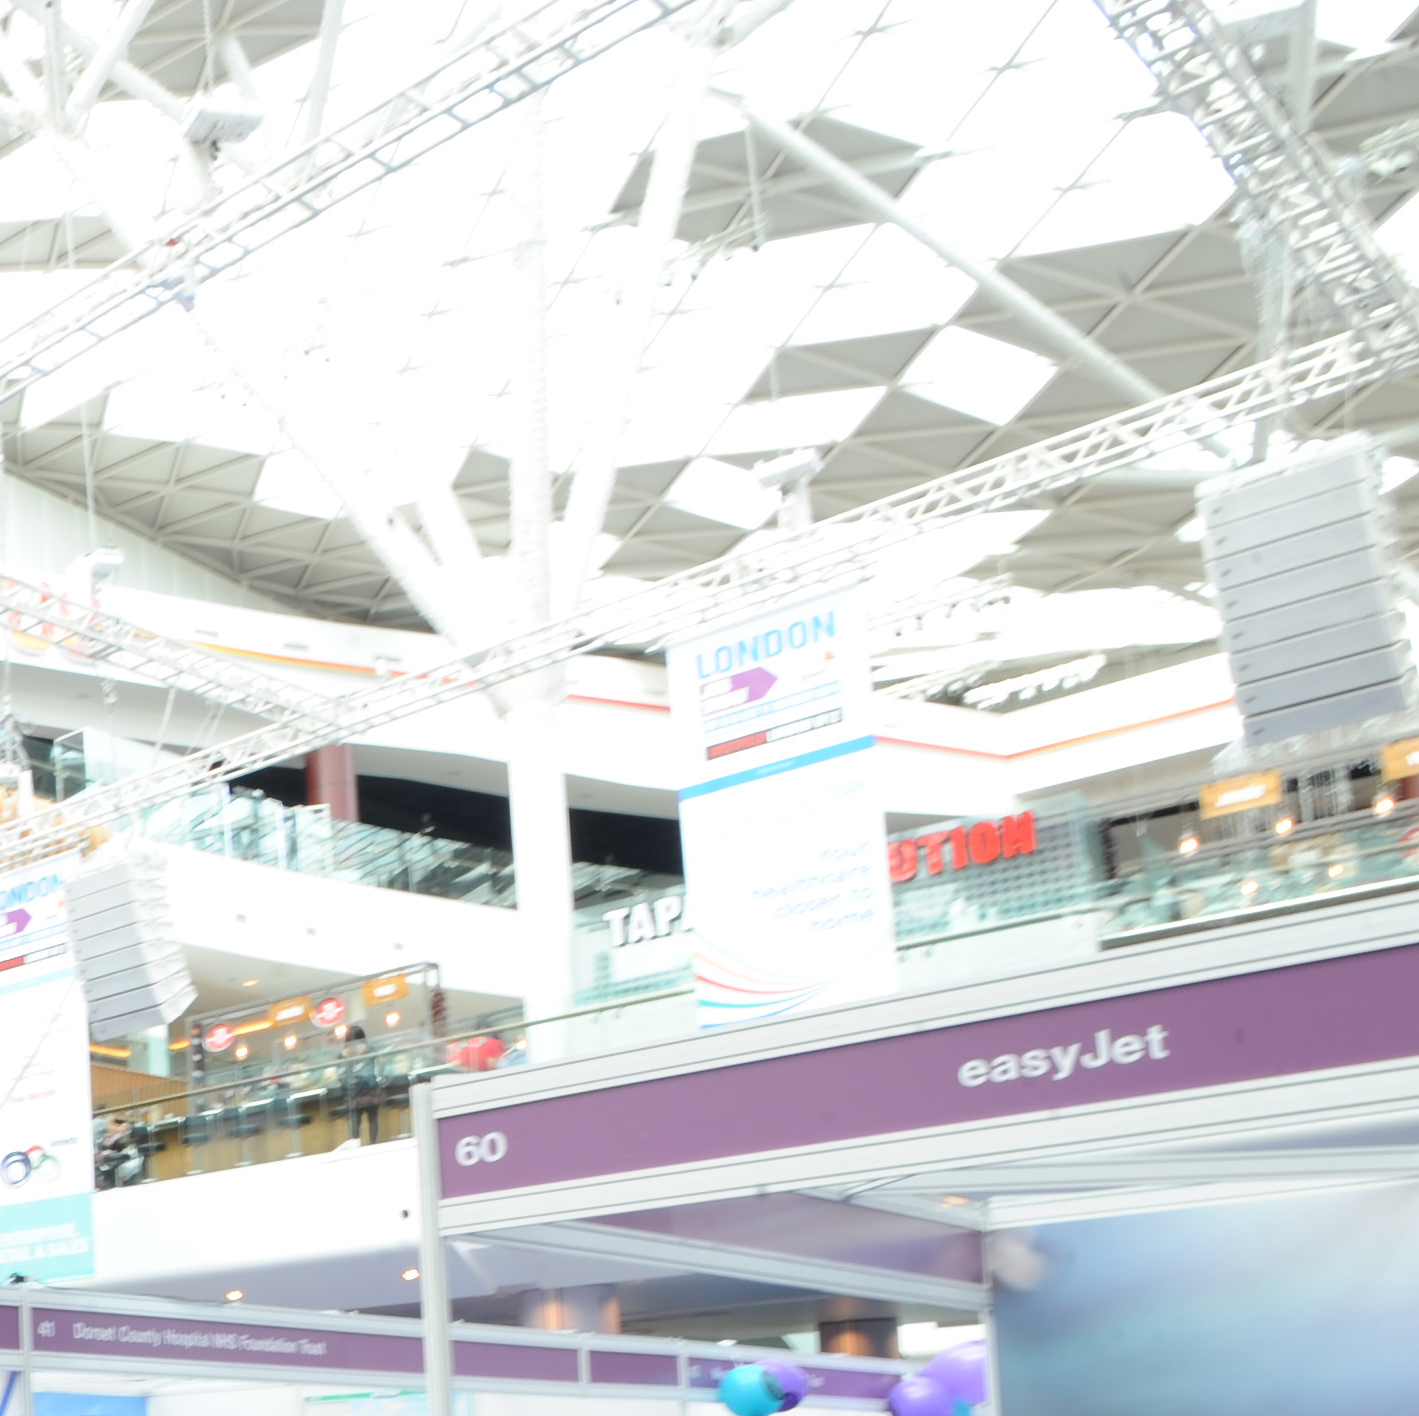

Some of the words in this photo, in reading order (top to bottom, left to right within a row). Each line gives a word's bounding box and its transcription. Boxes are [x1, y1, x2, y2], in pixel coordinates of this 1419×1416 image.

[695, 609, 836, 680] LONDON
[957, 1023, 1172, 1088] easyJet
[454, 1131, 508, 1167] 60
[72, 1321, 116, 1342] Dorset
[117, 1323, 162, 1347] County
[163, 1328, 211, 1350] Hospital
[239, 1335, 297, 1355] Foundation
[298, 1337, 328, 1356] Trust
